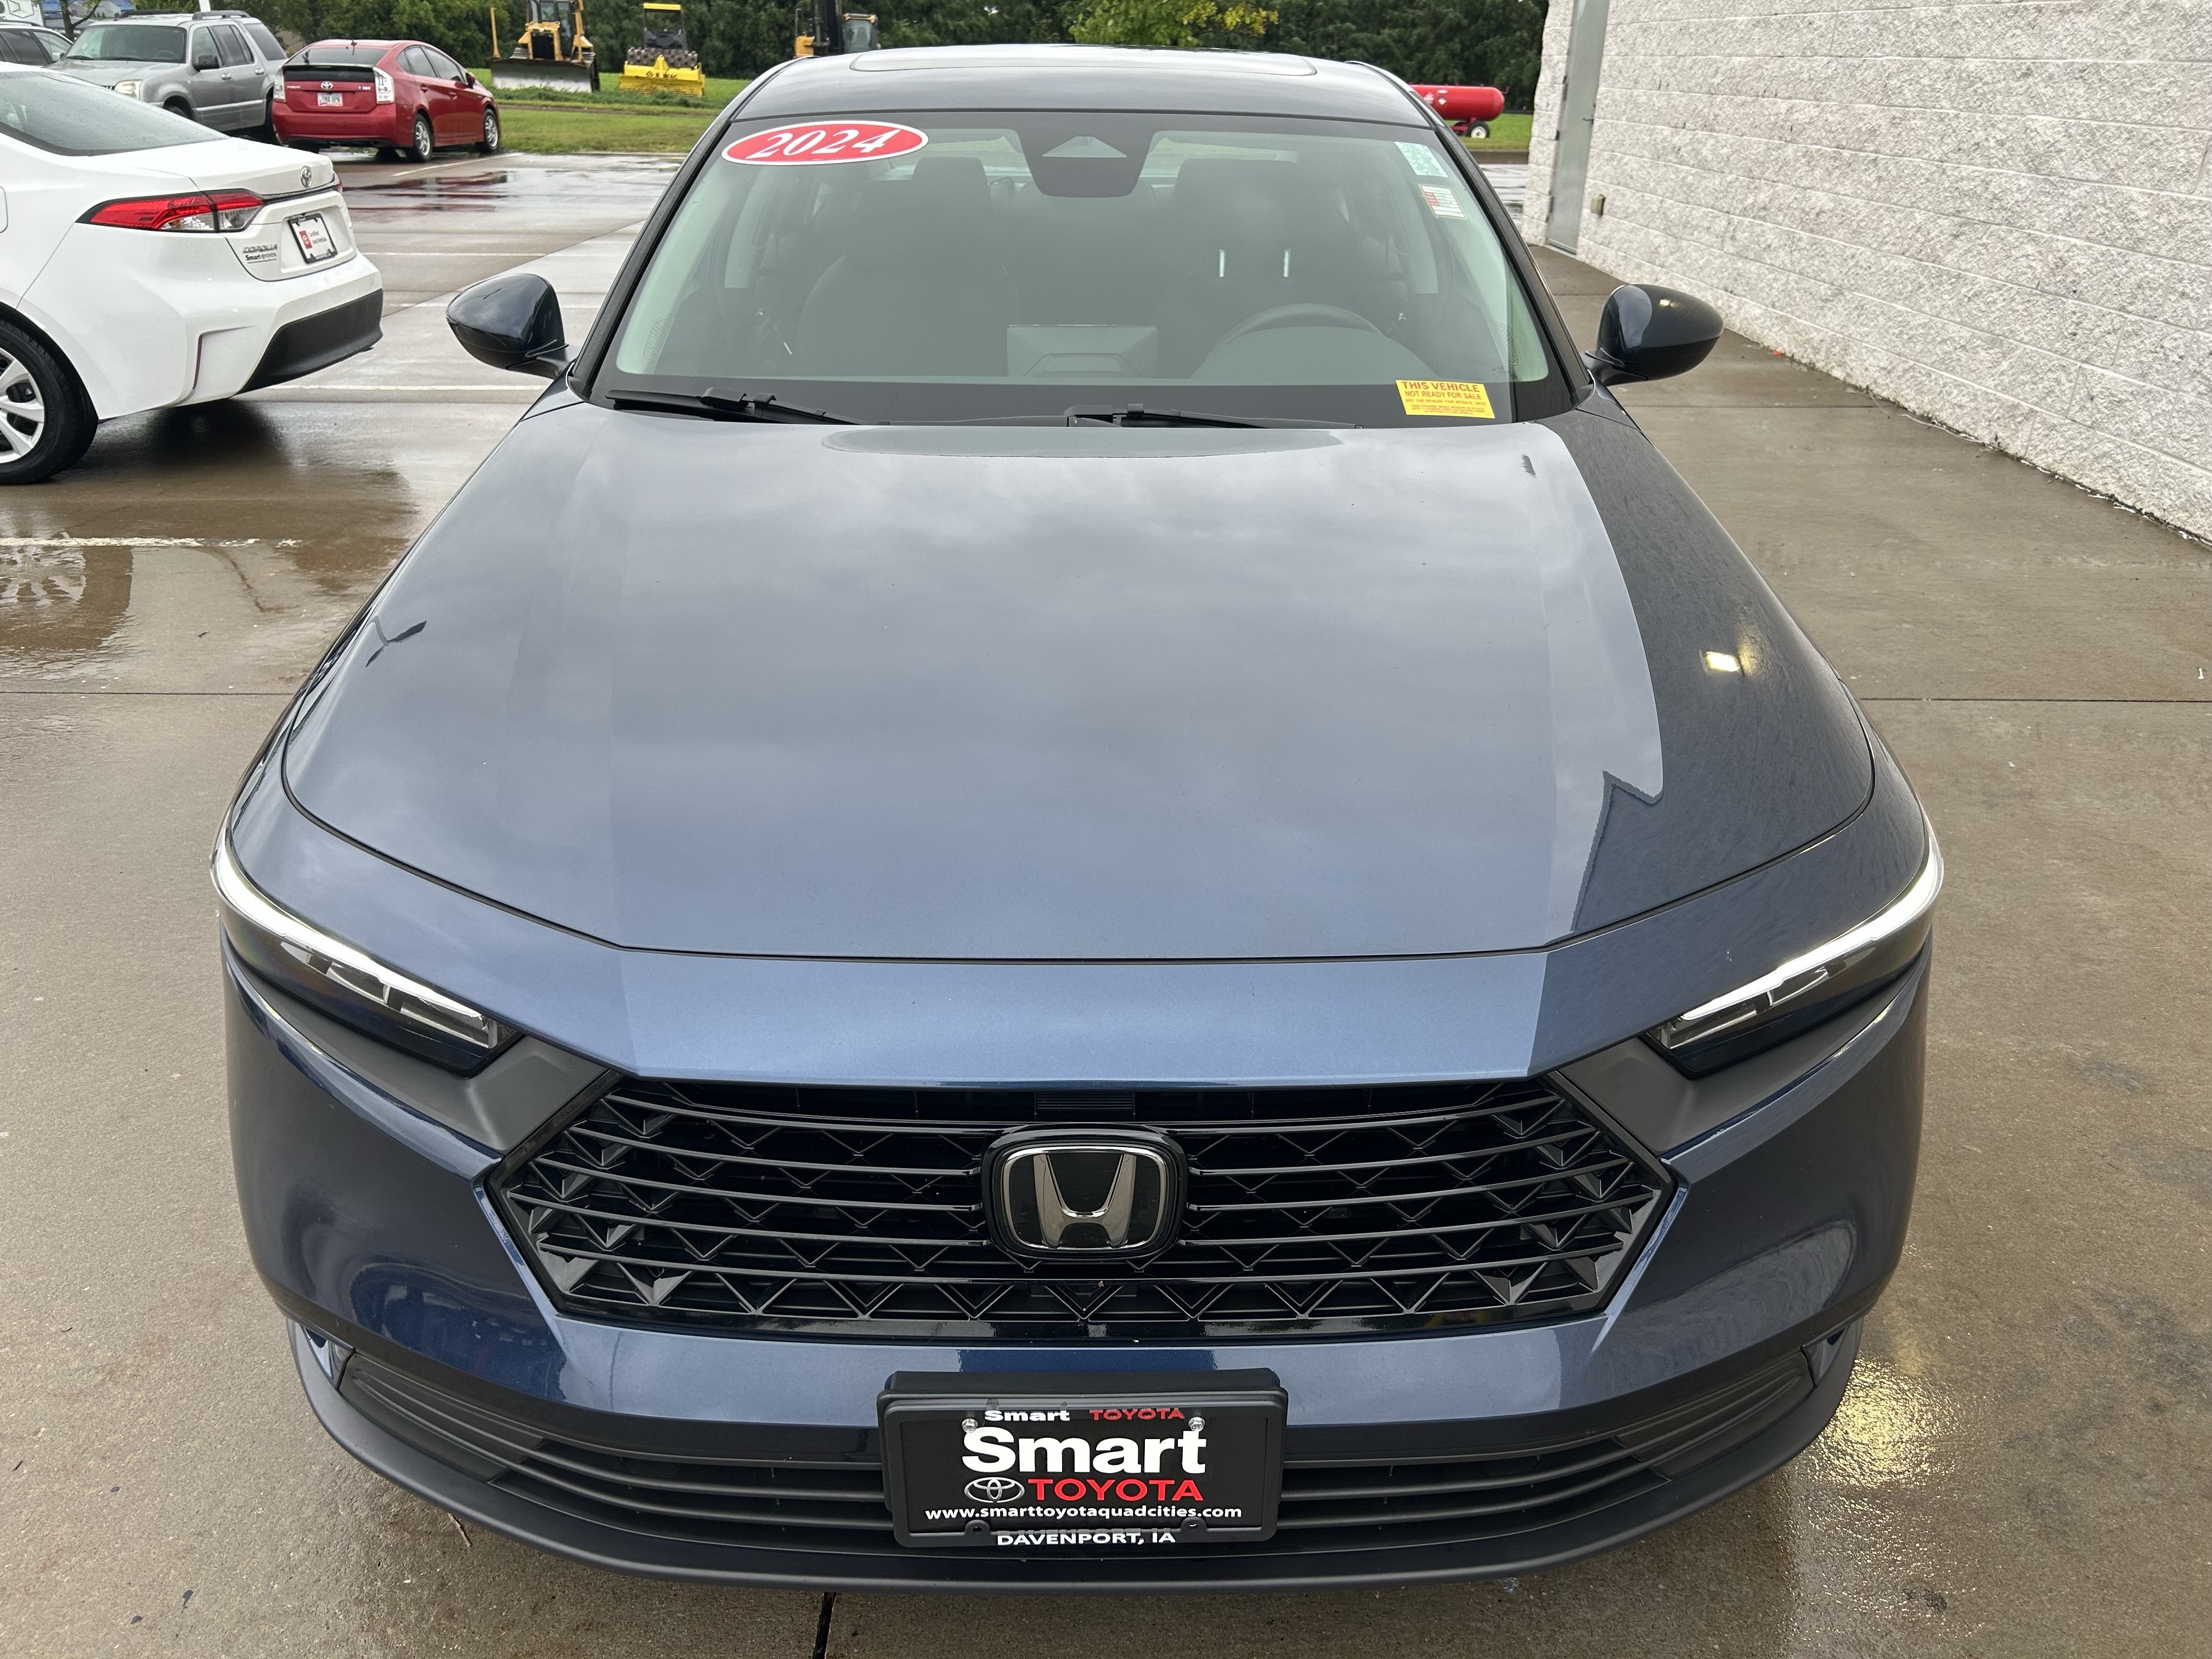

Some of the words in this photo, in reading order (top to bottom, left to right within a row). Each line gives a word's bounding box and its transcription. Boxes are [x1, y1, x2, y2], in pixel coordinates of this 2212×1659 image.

[744, 129, 902, 160] 2024
[1401, 381, 1429, 390] THIS
[1430, 382, 1480, 392] VEHICLE
[985, 1410, 1070, 1421] Smart
[1089, 1408, 1185, 1420] TOYOTA
[962, 1426, 1206, 1474] Smart
[1028, 1478, 1204, 1502] TOYOTA
[925, 1505, 1242, 1520] www.smarttoyotaquadcities.com
[997, 1532, 1144, 1545] DAVENPORT,
[1152, 1532, 1176, 1543] IA
